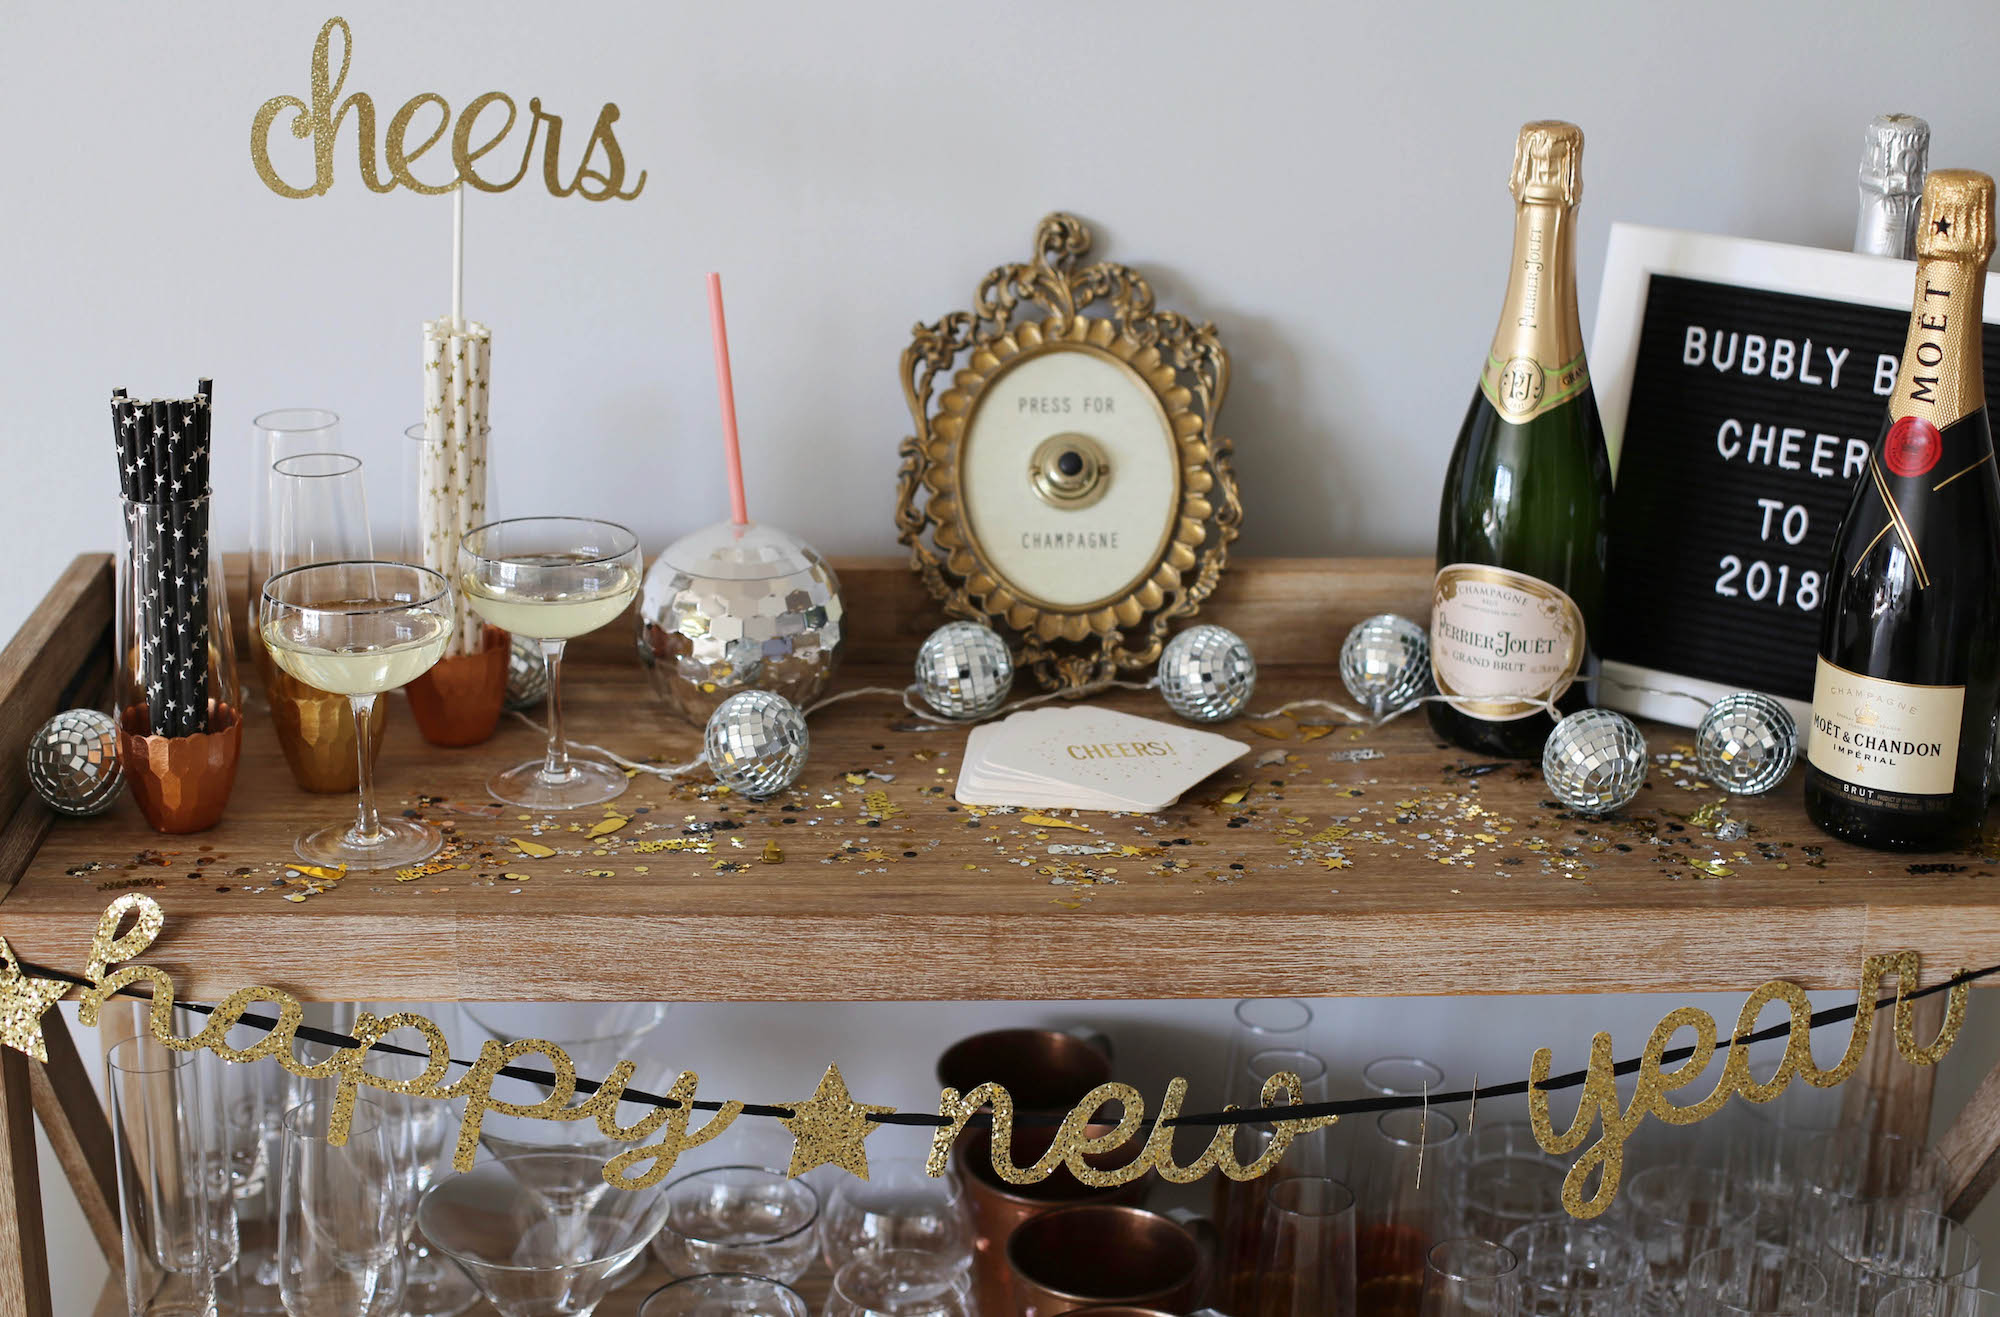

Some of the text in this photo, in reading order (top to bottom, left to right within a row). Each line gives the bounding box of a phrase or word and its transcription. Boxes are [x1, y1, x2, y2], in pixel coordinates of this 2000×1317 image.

[250, 16, 647, 201] cheers
[1683, 325, 1850, 389] BUBBLY
[1910, 281, 1950, 405] MOËT
[1018, 397, 1115, 413] PRESS FOR
[1757, 498, 1809, 545] TO
[1022, 532, 1119, 549] CHAMPAGNE
[1456, 583, 1529, 607] CHAMPAGNE
[1715, 555, 1821, 611] 2018
[1452, 650, 1490, 669] GRAND
[1493, 661, 1526, 673] BRUT
[1830, 686, 1919, 716] CHAMPAGNE
[1813, 712, 1841, 742] MOËT
[1842, 731, 1851, 744] &
[1854, 732, 1942, 757] CHANDON
[1066, 740, 1176, 761] CHEERS!
[1833, 743, 1896, 766] IMPÉRIAL
[1843, 783, 1875, 798] BRUT
[78, 892, 1970, 1220] happy new year
